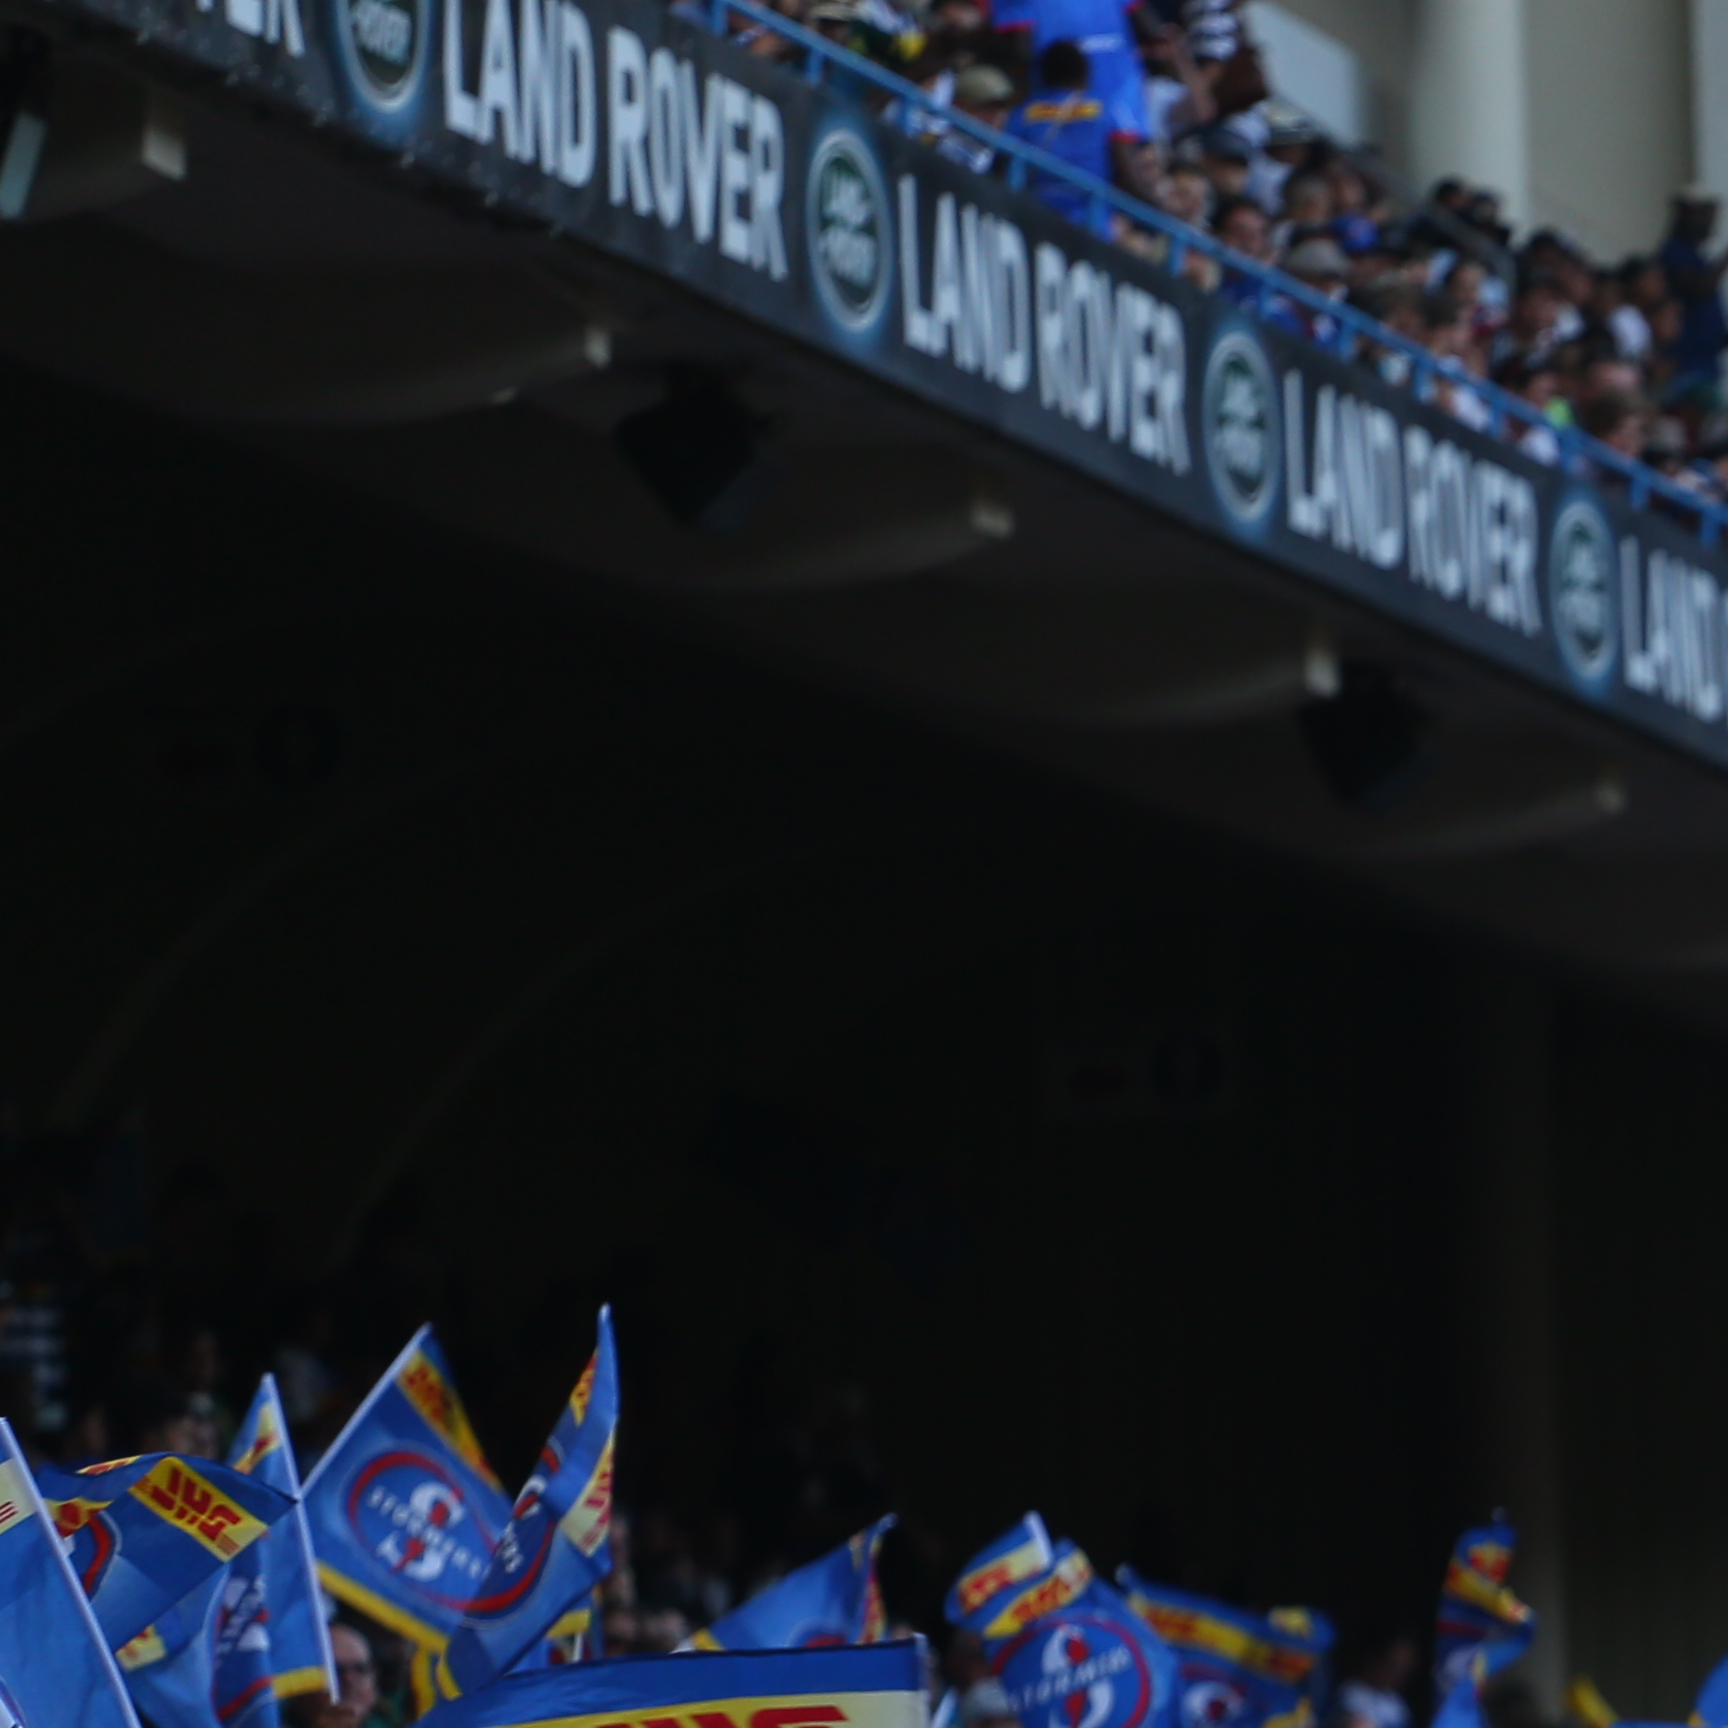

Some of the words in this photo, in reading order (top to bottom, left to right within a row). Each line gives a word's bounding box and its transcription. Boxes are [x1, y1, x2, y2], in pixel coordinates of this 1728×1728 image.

[443, 0, 597, 188] LAND
[607, 26, 788, 281] ROVER
[899, 173, 1031, 394] LAND
[1035, 240, 1192, 476] ROVER
[1285, 368, 1402, 570] LAND
[1403, 424, 1543, 638] ROVER
[1620, 535, 1723, 723] LAND
